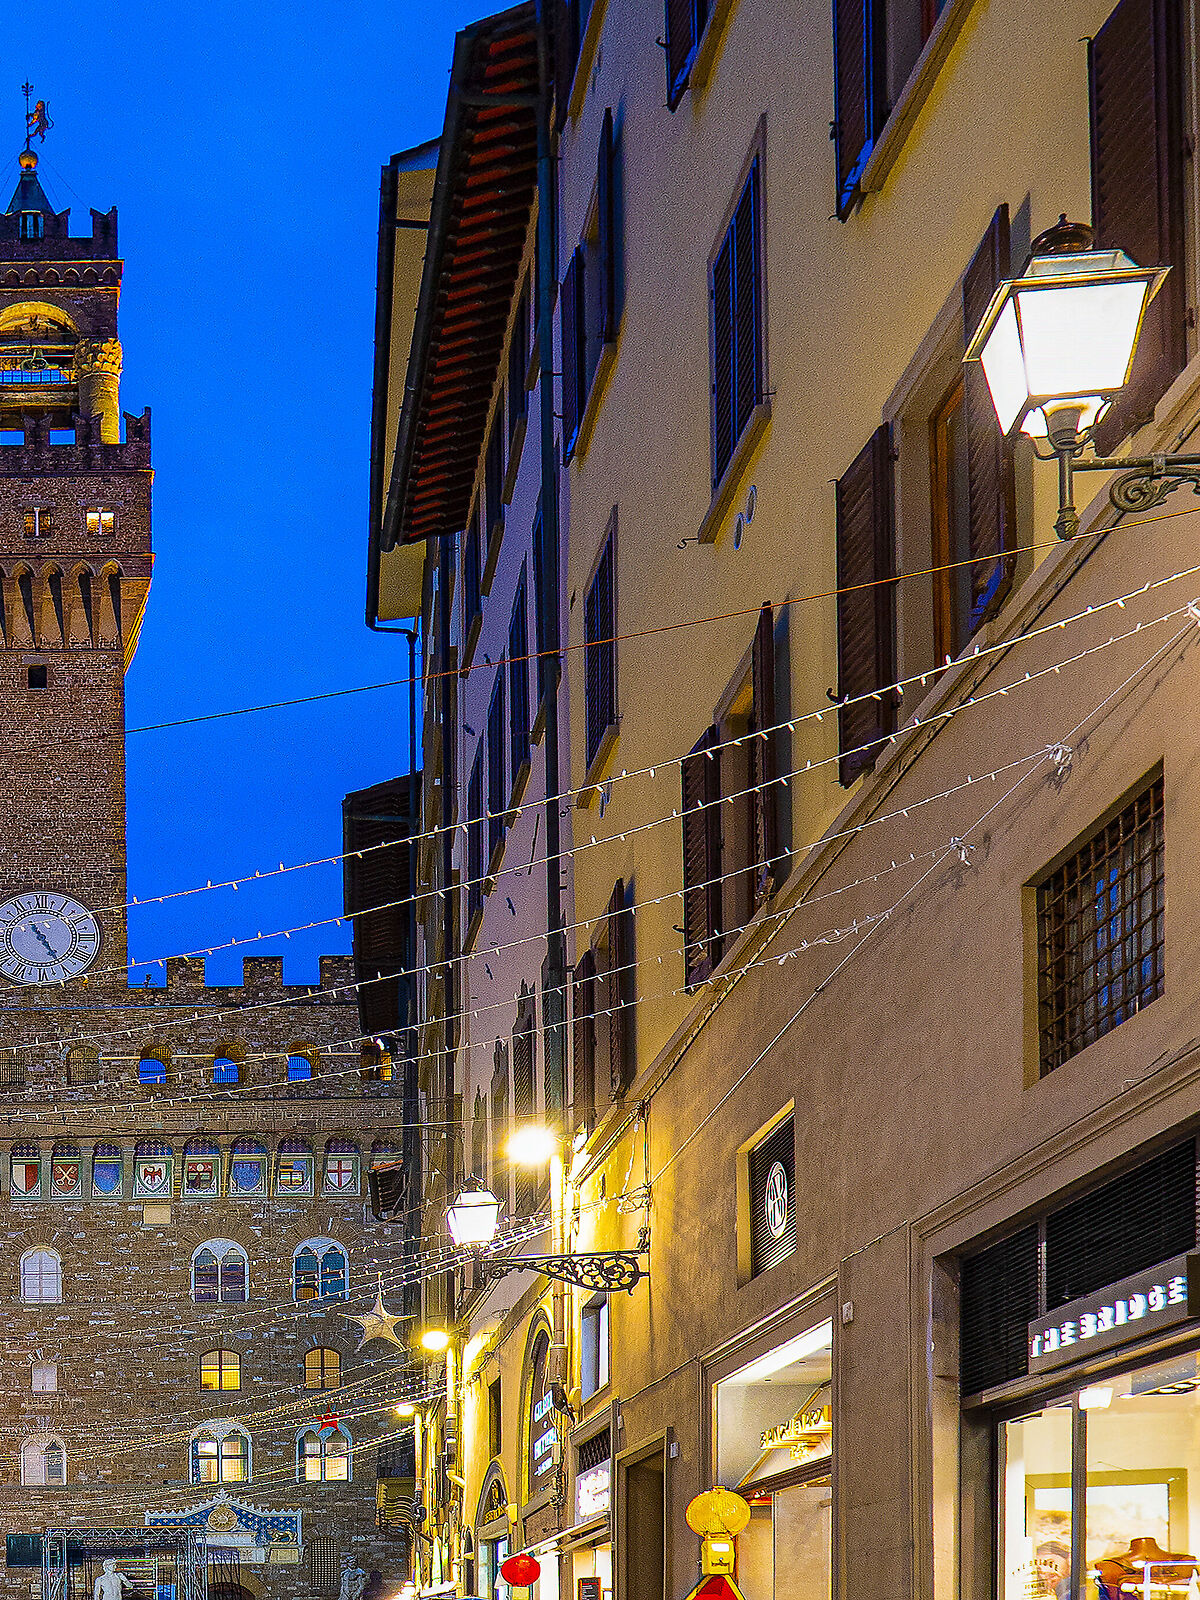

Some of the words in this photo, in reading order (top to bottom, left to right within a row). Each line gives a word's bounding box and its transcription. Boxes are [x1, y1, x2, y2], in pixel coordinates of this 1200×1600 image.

[33, 895, 49, 909] XII
[1030, 1320, 1077, 1358] THE
[1079, 1276, 1188, 1340] BRIDGE
